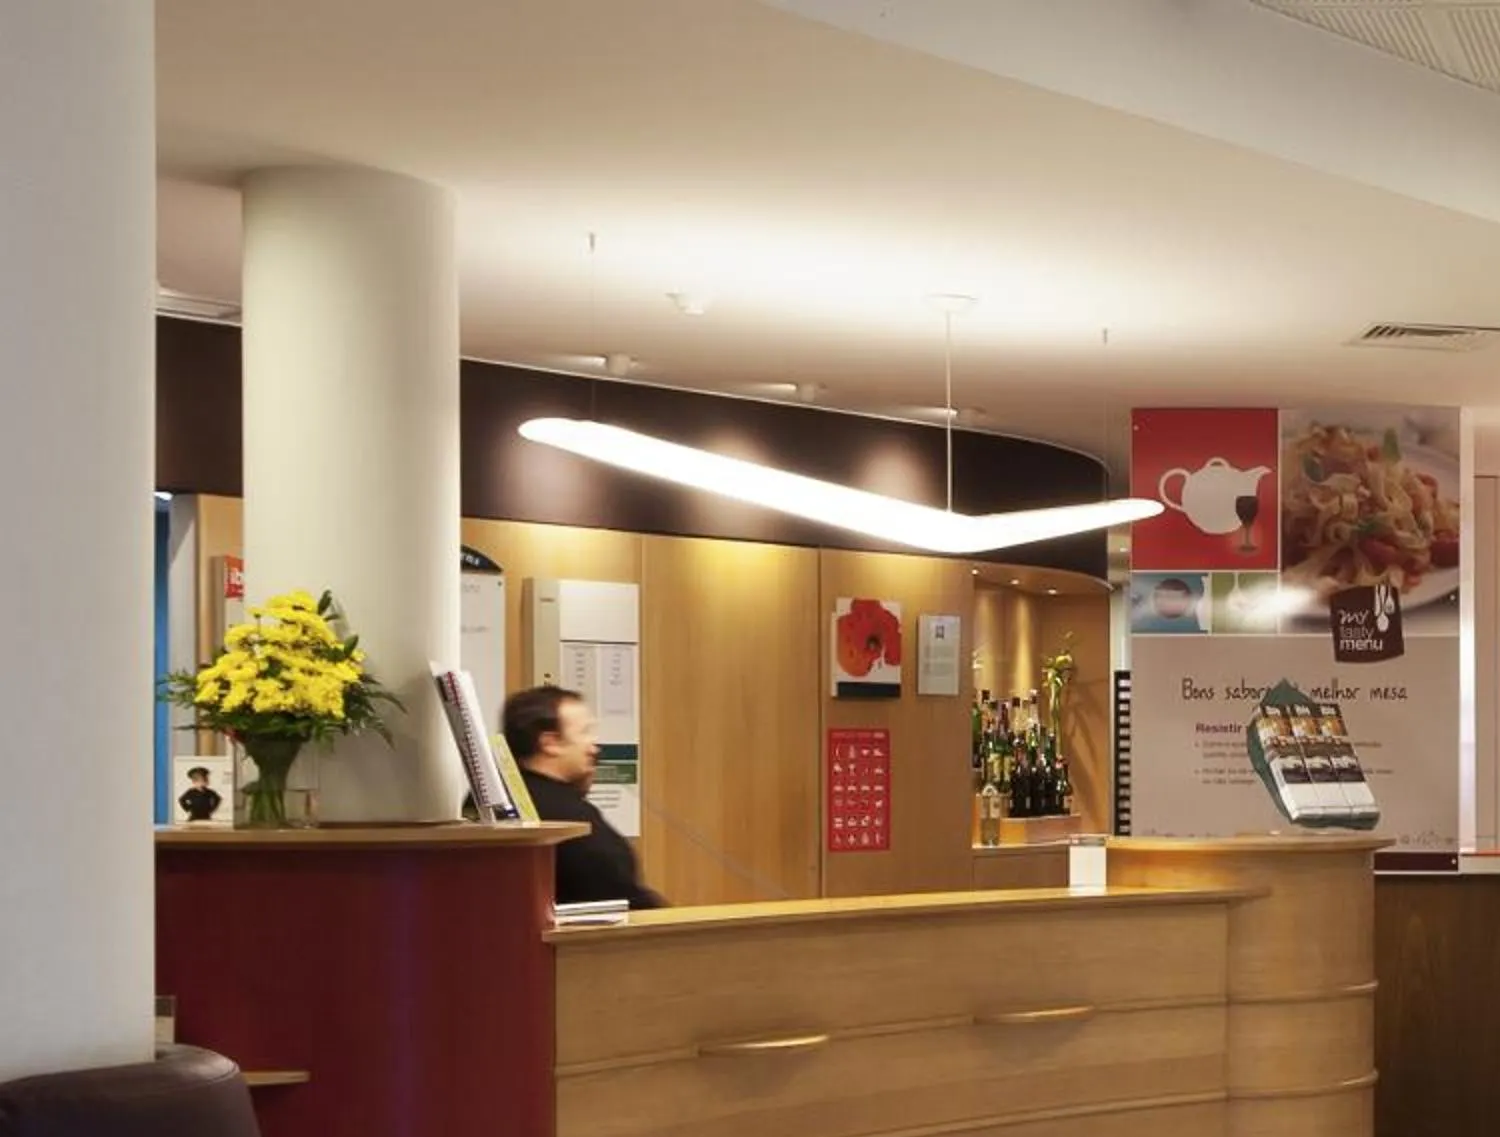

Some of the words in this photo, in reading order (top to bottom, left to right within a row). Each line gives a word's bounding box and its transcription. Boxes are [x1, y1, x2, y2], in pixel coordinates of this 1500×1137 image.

[1338, 609, 1369, 625] my
[1340, 639, 1383, 651] menu
[1181, 677, 1215, 700] Bons
[1369, 686, 1408, 700] mesa
